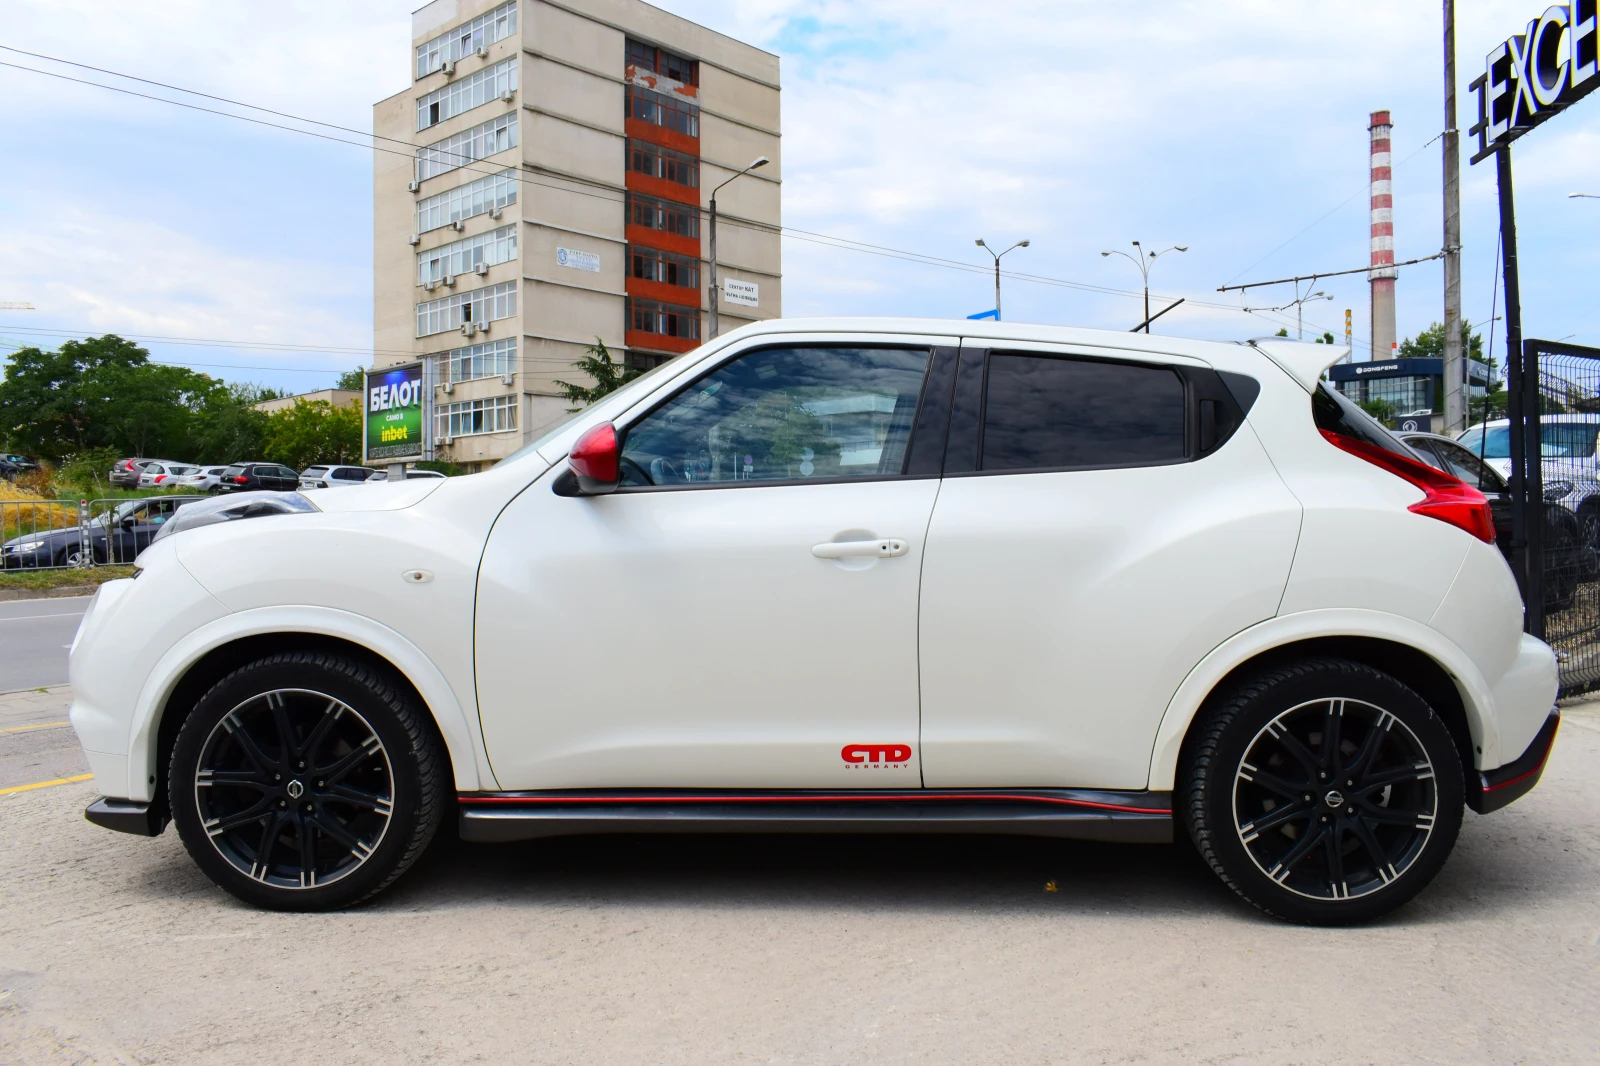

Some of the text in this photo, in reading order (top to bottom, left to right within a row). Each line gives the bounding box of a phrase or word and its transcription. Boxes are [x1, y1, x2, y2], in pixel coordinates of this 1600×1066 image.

[1487, 0, 1600, 143] EXCE
[745, 285, 754, 293] КАТ
[1363, 364, 1398, 373] DONGFENG
[371, 379, 421, 412] БЕЛОТ
[382, 425, 408, 442] inbet
